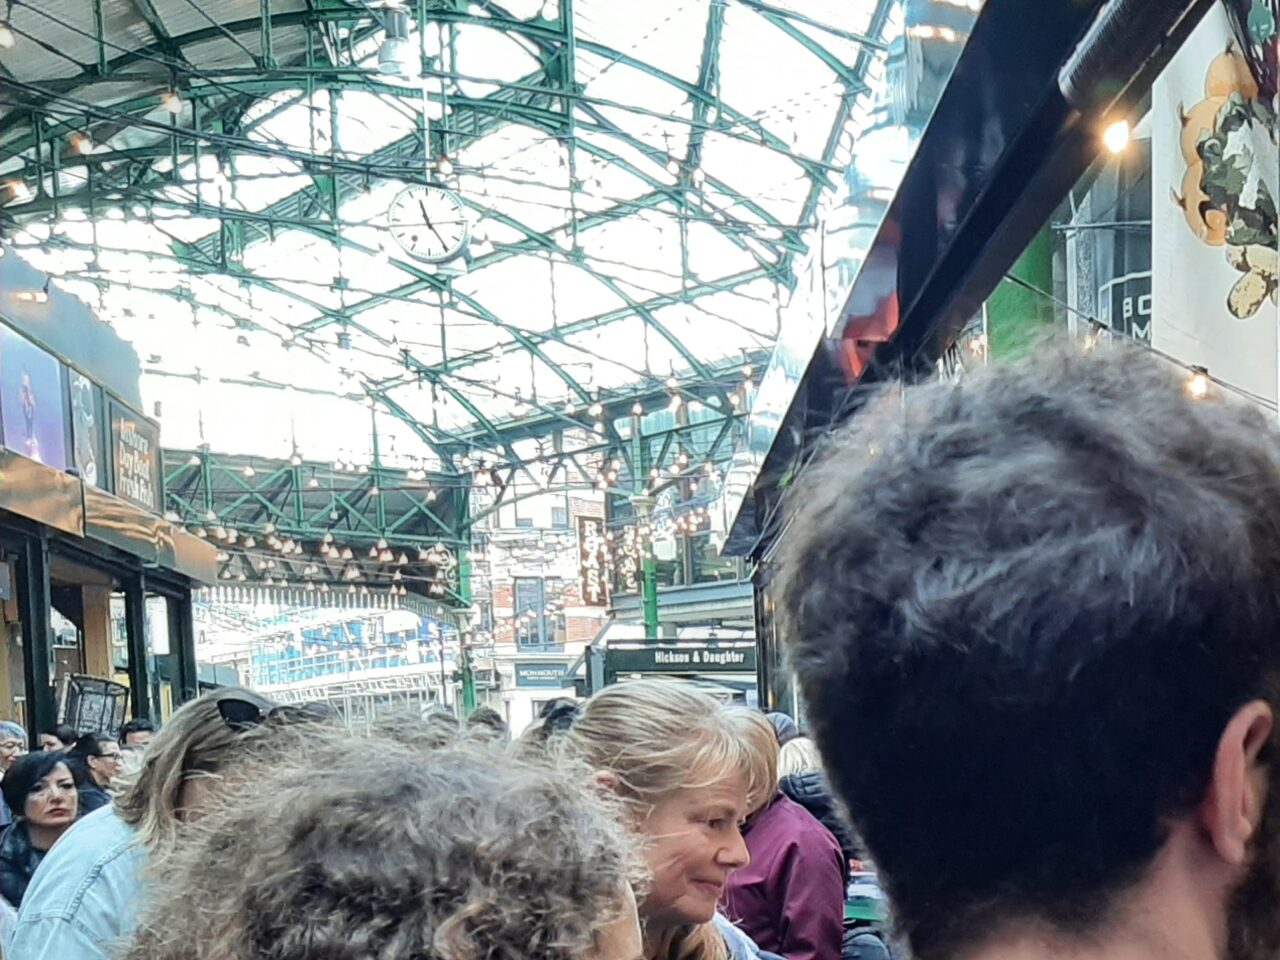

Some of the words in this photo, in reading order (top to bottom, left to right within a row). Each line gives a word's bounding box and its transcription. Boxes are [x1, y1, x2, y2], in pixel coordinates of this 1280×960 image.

[119, 440, 133, 479] Day
[133, 450, 150, 481] Boat
[119, 467, 139, 500] Fresh
[140, 478, 155, 509] Fish
[581, 520, 603, 602] ROAST
[655, 650, 690, 663] Hickson
[692, 650, 700, 663] &
[702, 650, 745, 665] Daughter
